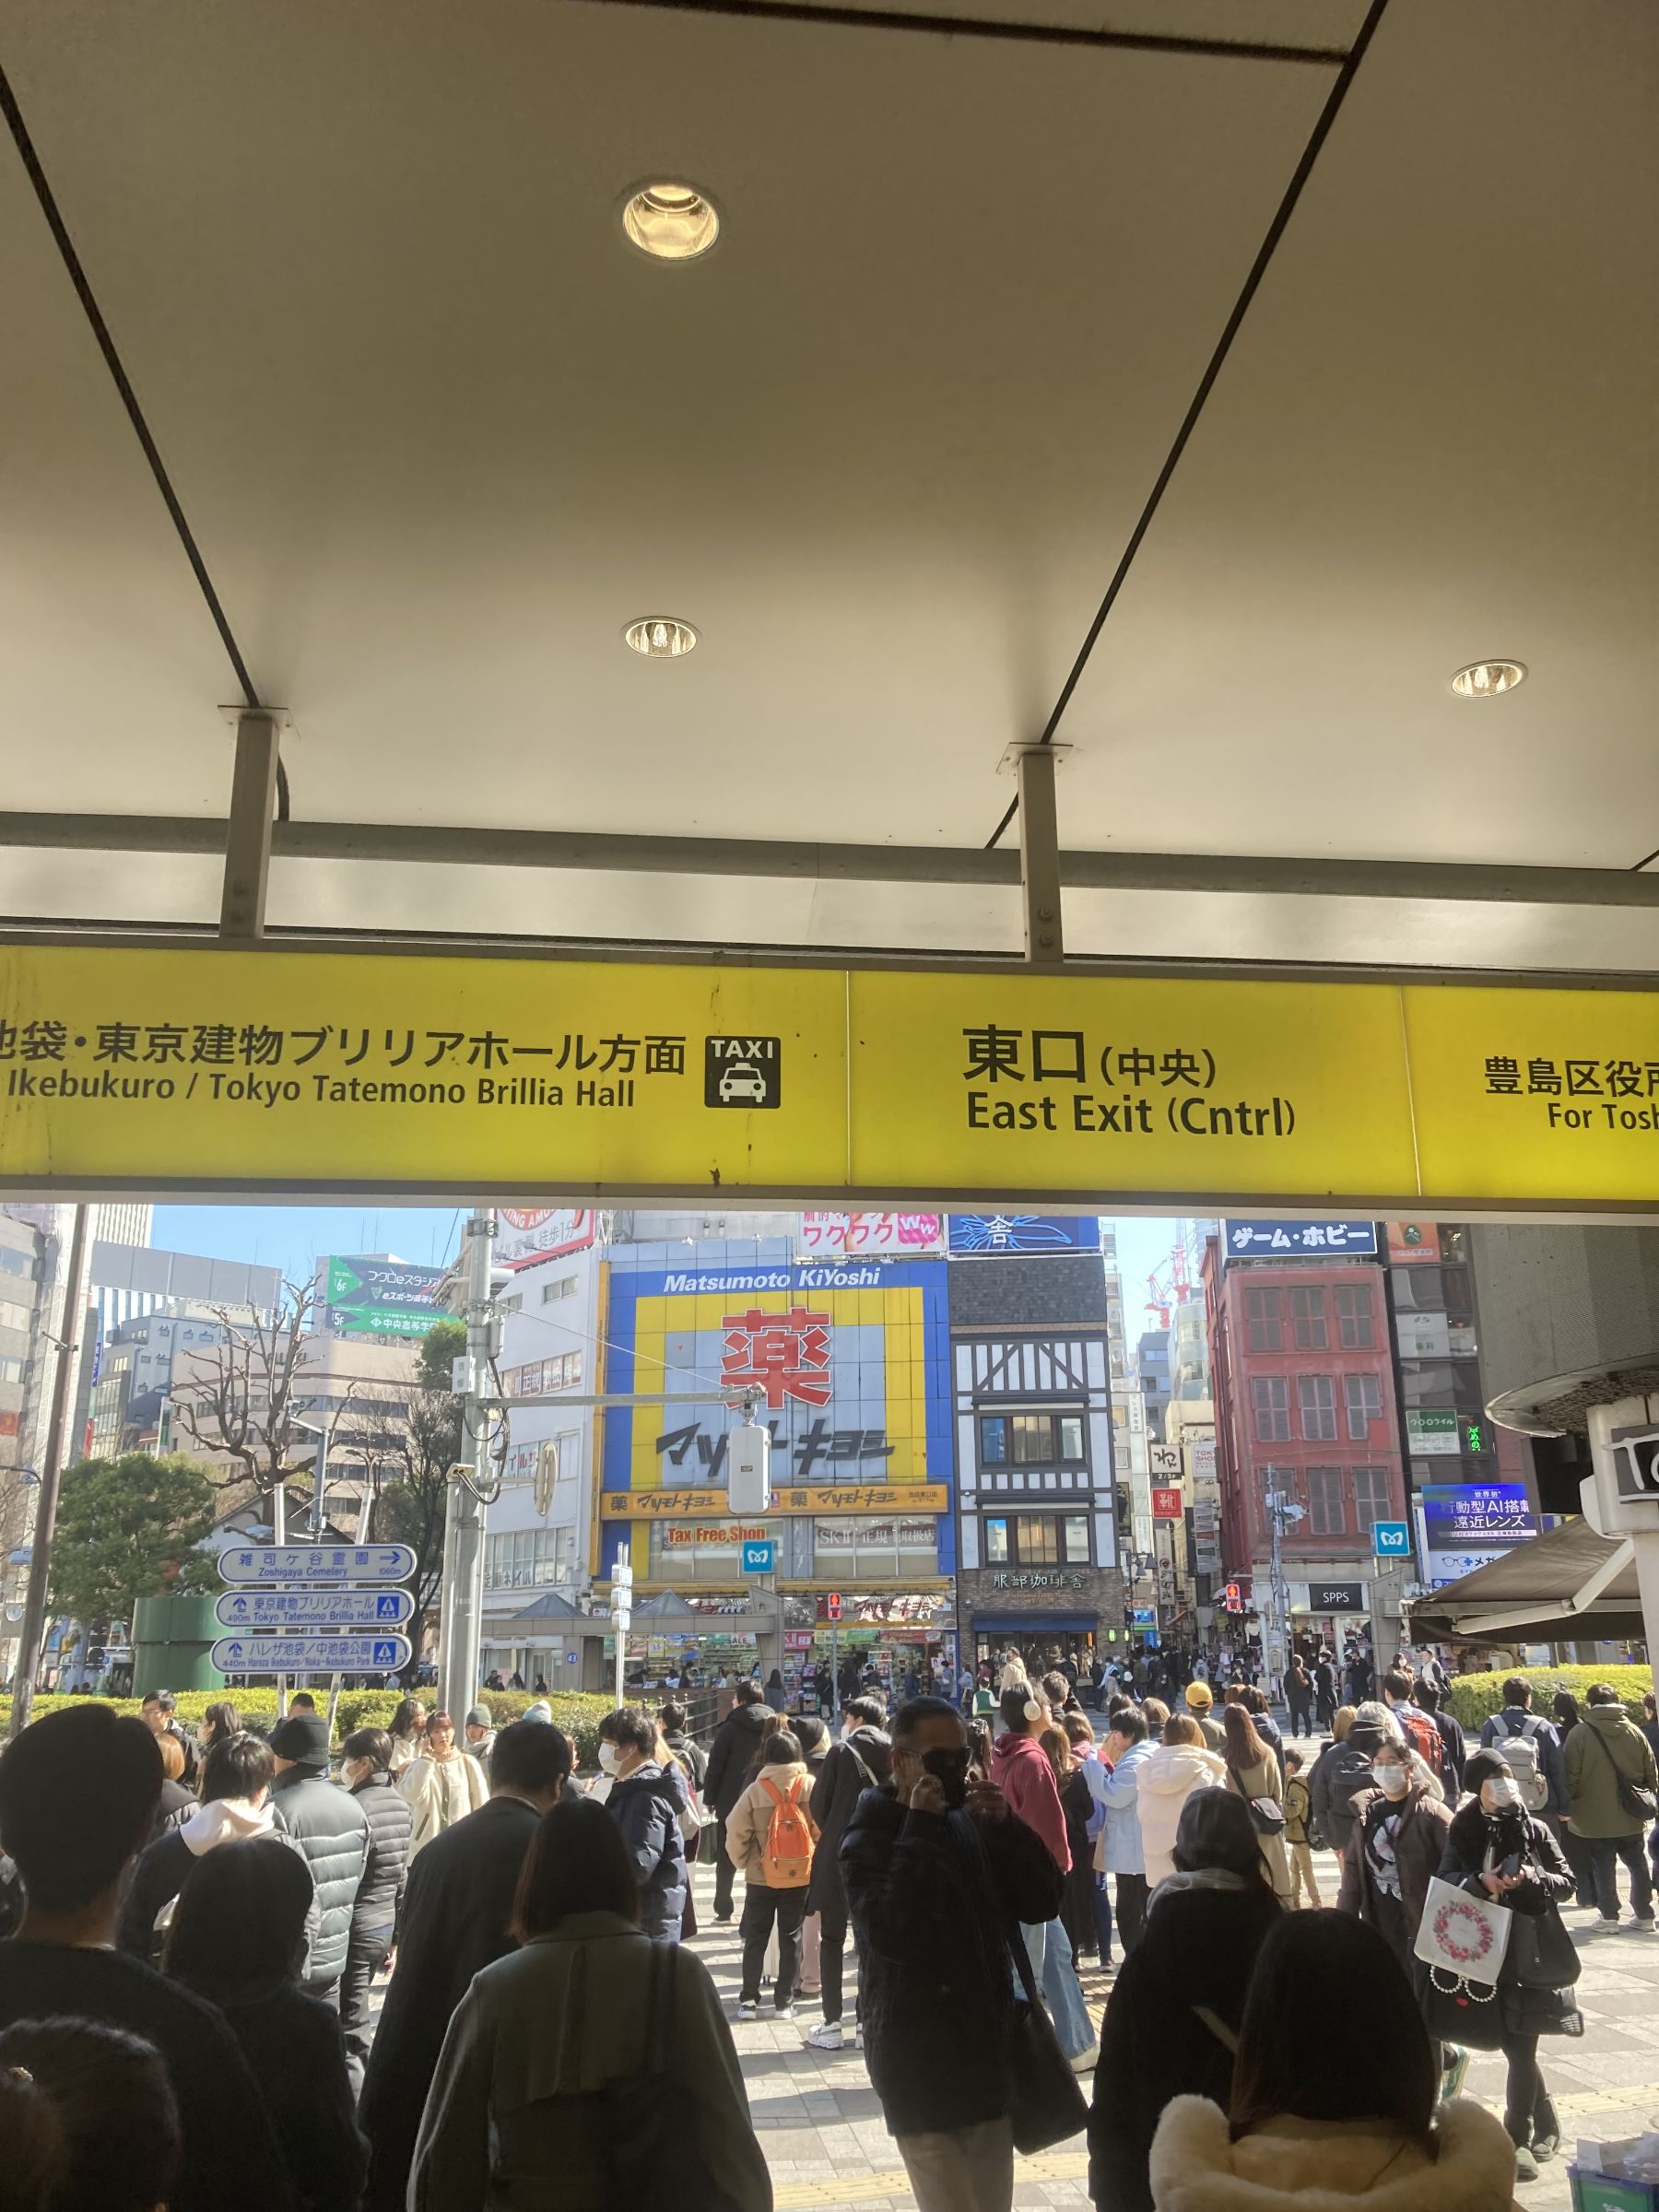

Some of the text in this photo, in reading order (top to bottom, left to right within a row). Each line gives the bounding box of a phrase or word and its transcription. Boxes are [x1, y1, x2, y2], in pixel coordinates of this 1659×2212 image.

[711, 1039, 774, 1060] TAXI
[961, 1024, 1087, 1084] 東口
[8, 1068, 175, 1099] Ikebukuro
[210, 1075, 300, 1108] Tokyo
[312, 1076, 465, 1105] Tatemono
[477, 1079, 564, 1107] Brillia
[576, 1081, 635, 1108] Hall
[968, 1092, 1296, 1136] East Exit (Cntrl)
[1548, 1102, 1659, 1130] For Tosh
[803, 1223, 893, 1247] ワクワク
[1231, 1224, 1370, 1249] ゲーム・ホビー
[663, 1266, 881, 1293] Matsumoto KiYoshi
[719, 1305, 834, 1410] 薬
[655, 1418, 896, 1477] マツトキヨシ
[611, 1496, 628, 1512] 薬
[637, 1493, 715, 1512] マツモトキヨシ
[791, 1491, 808, 1507] 薬
[818, 1488, 898, 1507] マツモトキヨシ
[1453, 1513, 1525, 1528] 遠近レンズ
[667, 1526, 767, 1543] Tax Free Shop
[258, 1567, 302, 1578] Zoshigaya
[994, 1572, 1086, 1589] 服部珈琲舎
[253, 1595, 375, 1611] 東京建物ブリリアホール
[1324, 1592, 1349, 1603] SPPS
[227, 1611, 374, 1624] 490m Tokyo Tatemono Brillia Hall
[568, 1654, 577, 1663] 43
